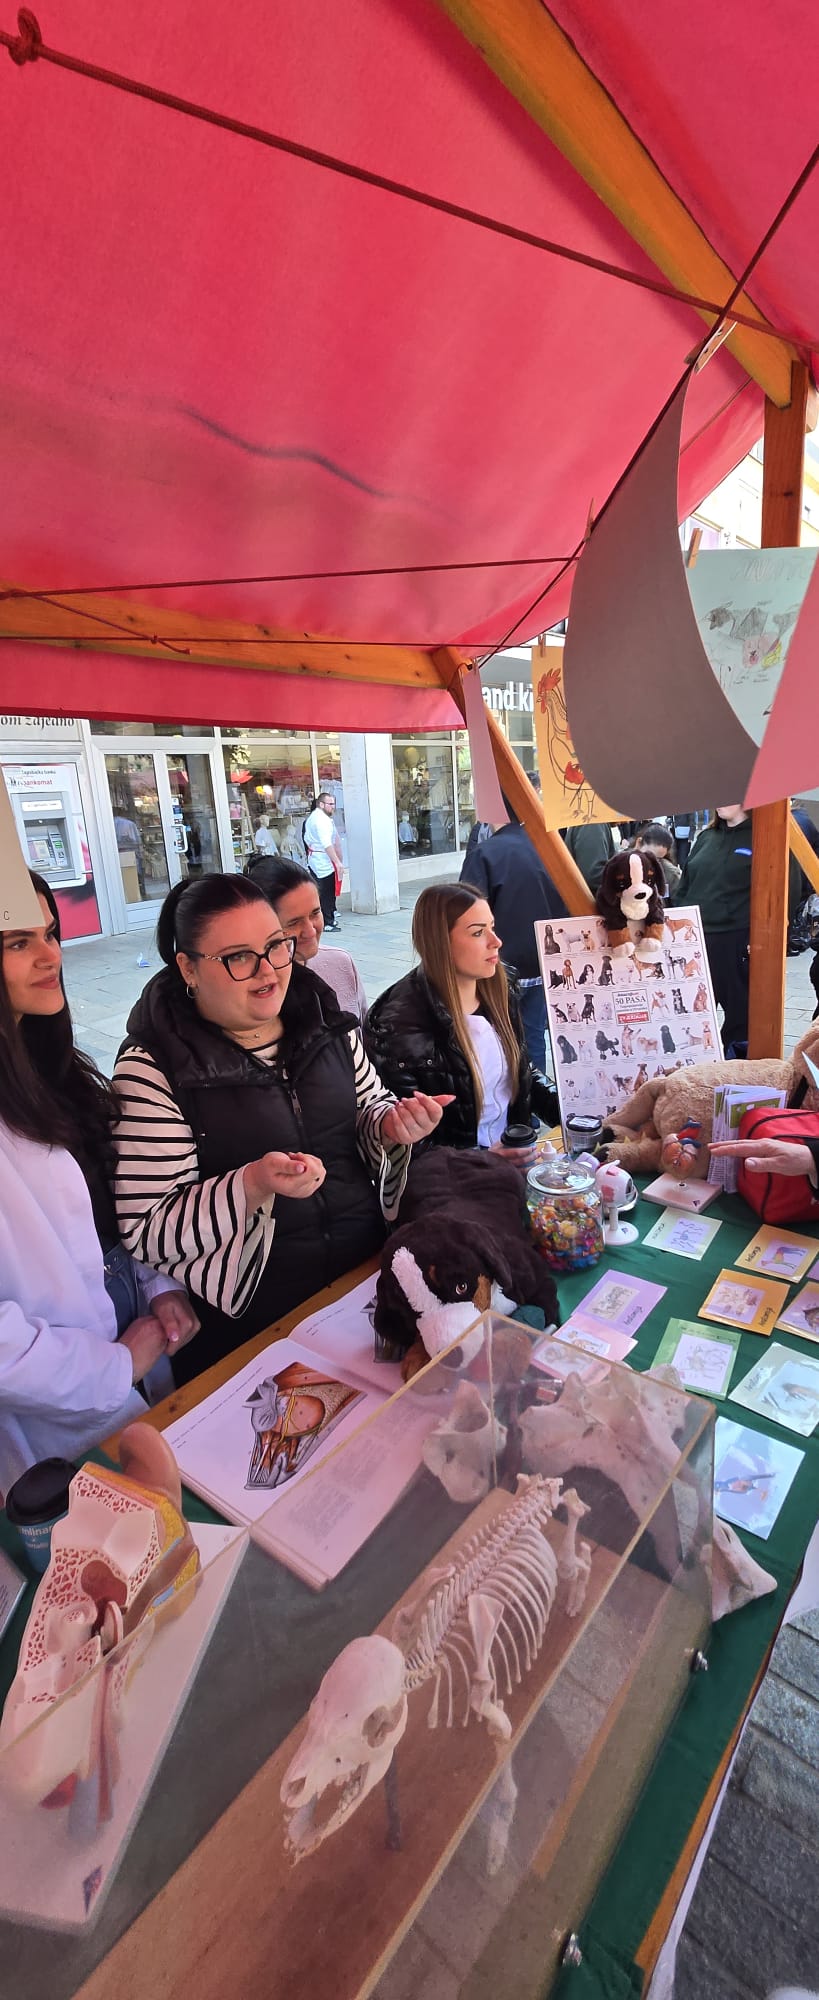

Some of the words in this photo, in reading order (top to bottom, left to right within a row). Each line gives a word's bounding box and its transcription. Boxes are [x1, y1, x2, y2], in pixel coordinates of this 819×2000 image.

[482, 681, 514, 710] and
[615, 997, 624, 1006] 50
[625, 995, 647, 1004] PASA
